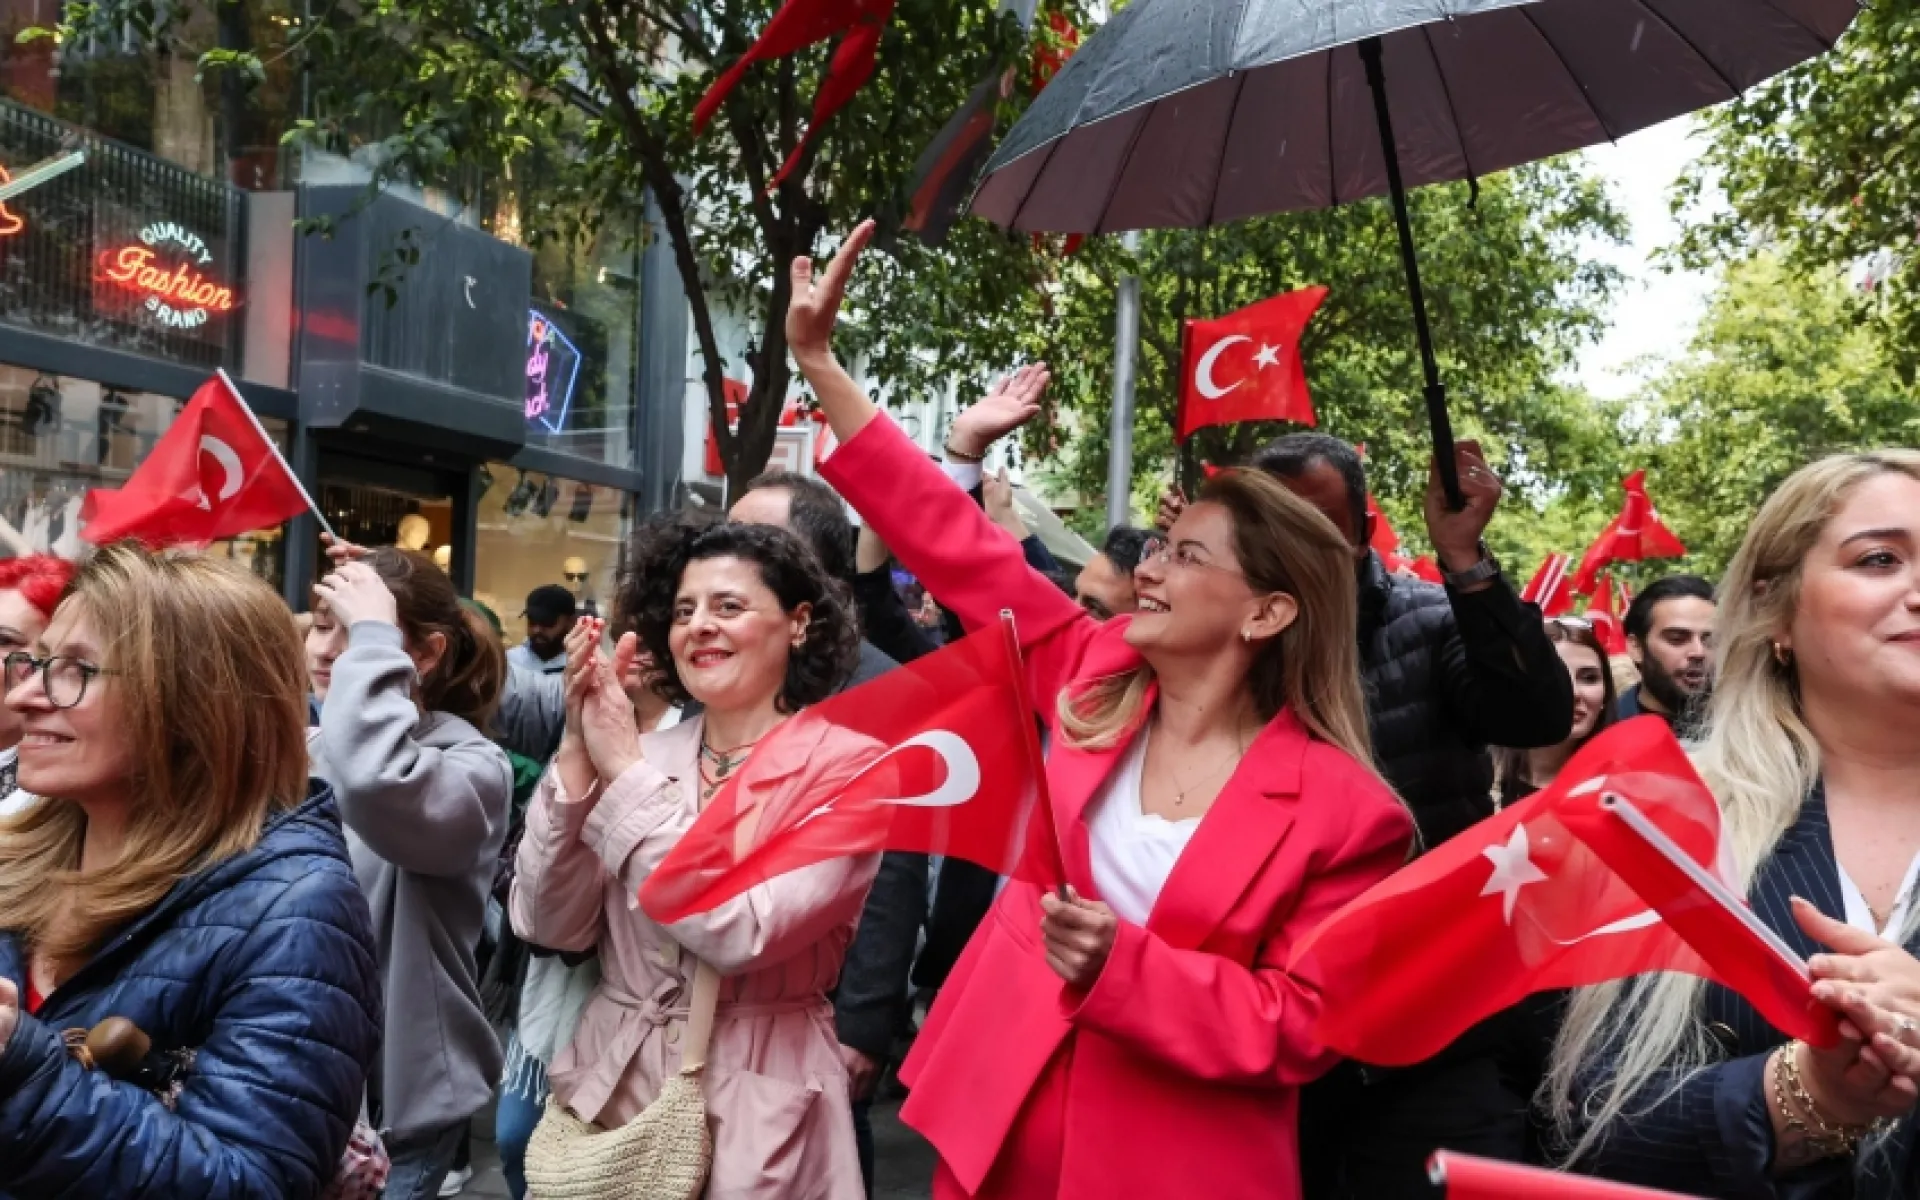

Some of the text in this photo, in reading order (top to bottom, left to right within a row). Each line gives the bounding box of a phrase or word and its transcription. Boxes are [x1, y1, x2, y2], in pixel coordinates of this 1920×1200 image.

[139, 222, 213, 263] QUALITY
[106, 246, 232, 311] Fashion
[145, 296, 207, 329] BRAND
